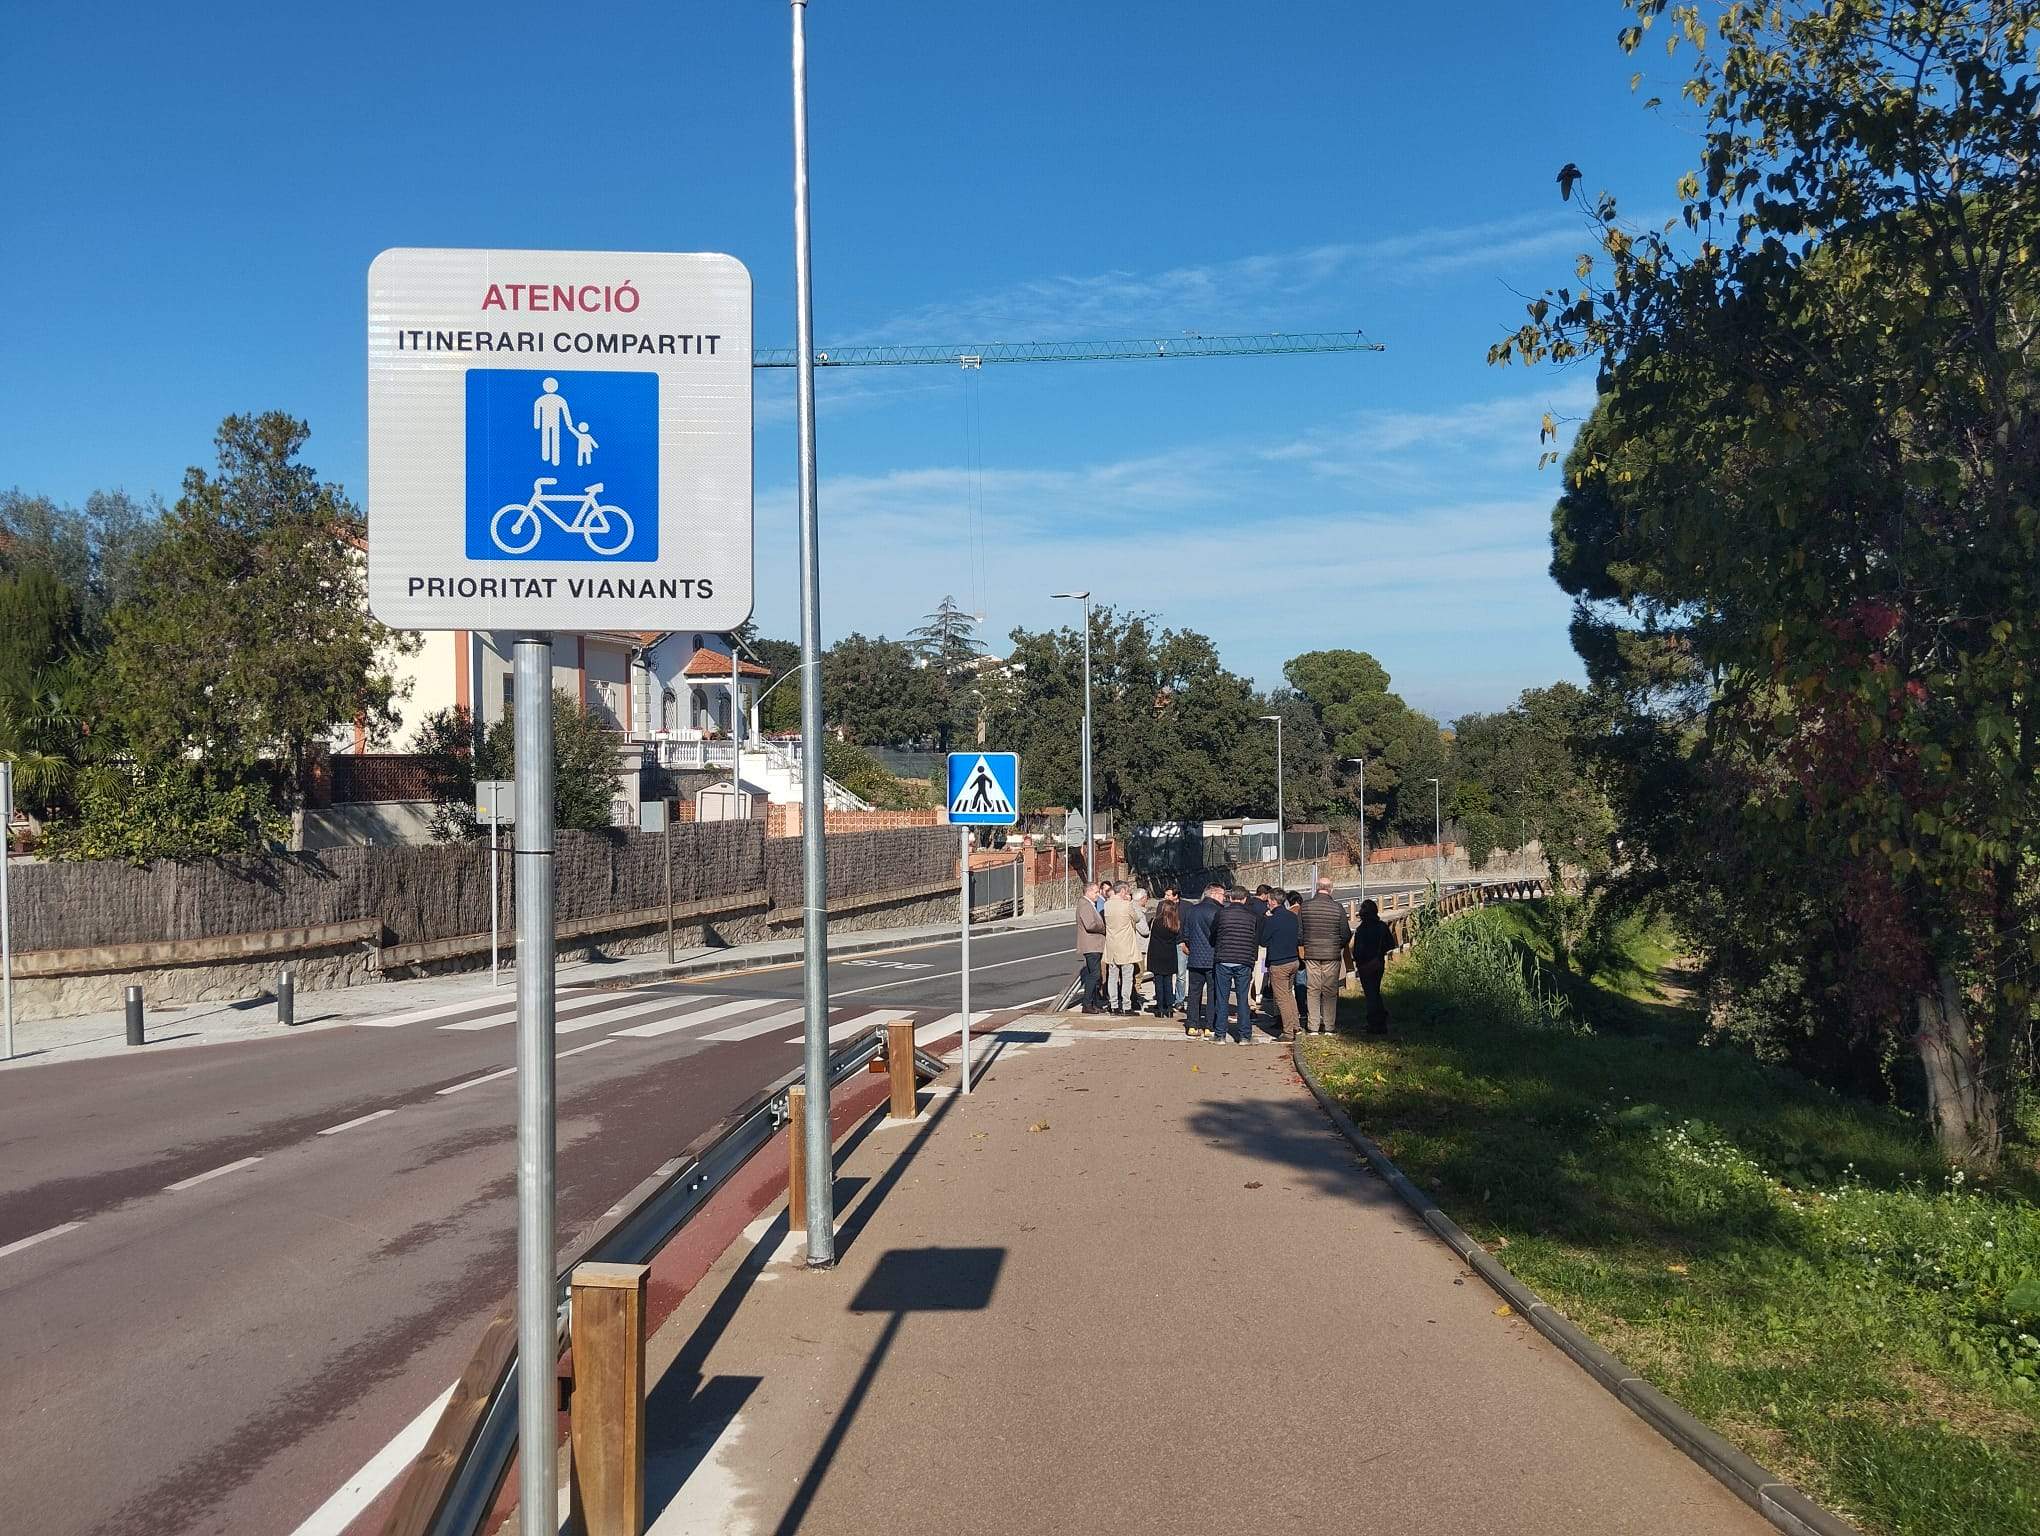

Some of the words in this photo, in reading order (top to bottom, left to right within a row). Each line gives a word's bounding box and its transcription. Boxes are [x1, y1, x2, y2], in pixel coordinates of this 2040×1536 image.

[481, 279, 641, 313] ATENCIÓ
[398, 330, 544, 353] ITINERARI
[553, 331, 721, 355] COMPARTIT
[408, 577, 558, 599] PRIORITAT
[567, 578, 715, 600] VIANANTS
[841, 959, 936, 970] BUS
